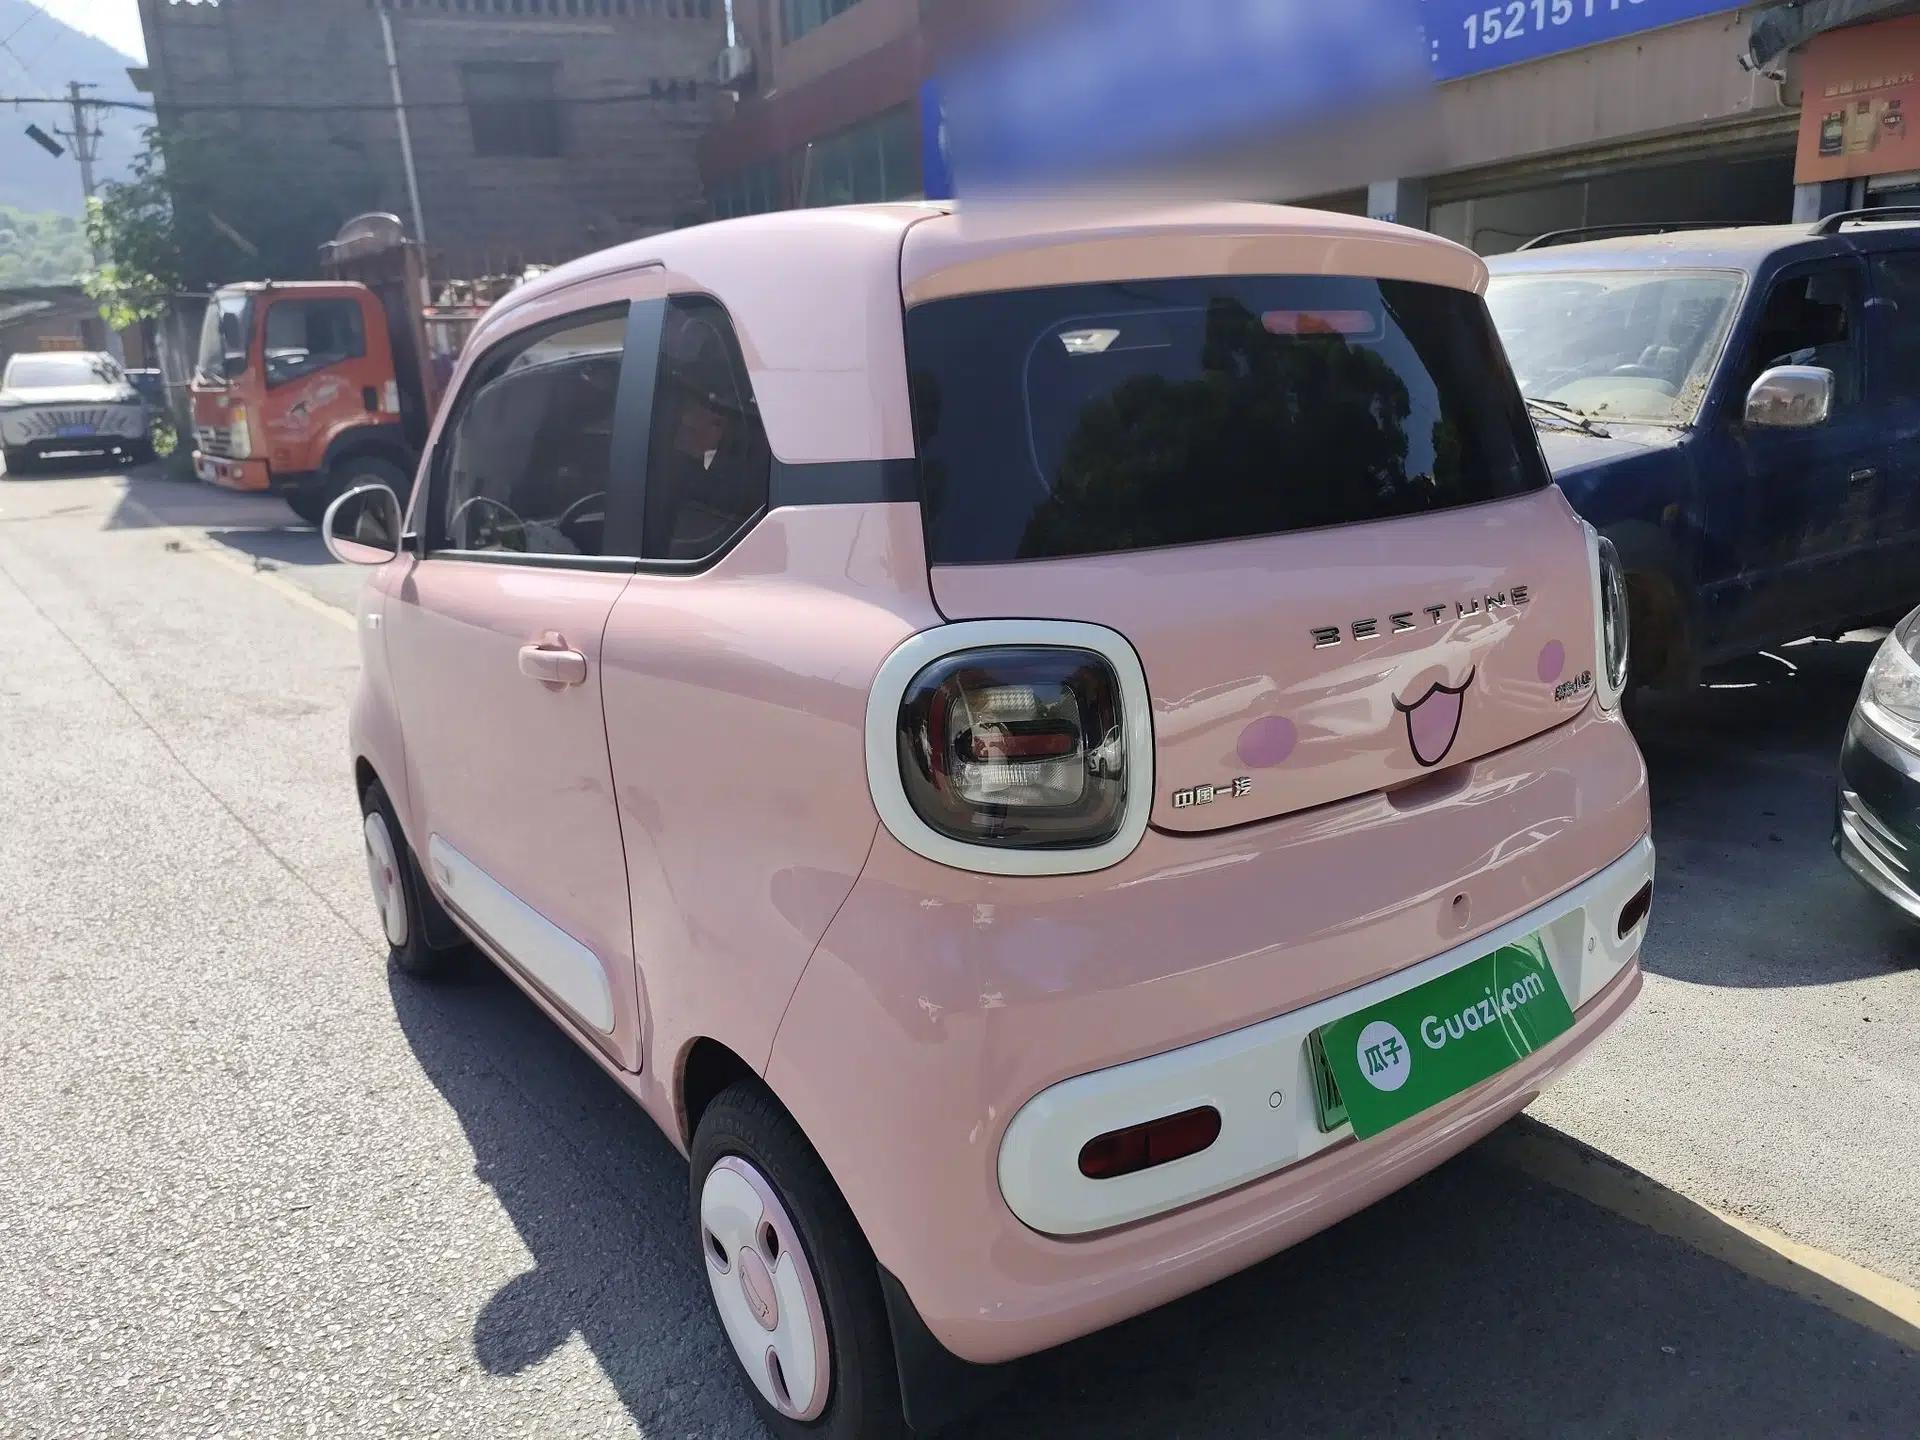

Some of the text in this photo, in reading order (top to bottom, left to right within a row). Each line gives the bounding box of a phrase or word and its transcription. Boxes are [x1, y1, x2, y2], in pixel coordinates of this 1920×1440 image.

[1463, 0, 1645, 49] 15215
[1311, 584, 1531, 649] BESTUNE
[1172, 776, 1252, 808] 中国一汽
[1420, 970, 1546, 1050] Guazi.com
[1364, 1036, 1403, 1076] 瓜子
